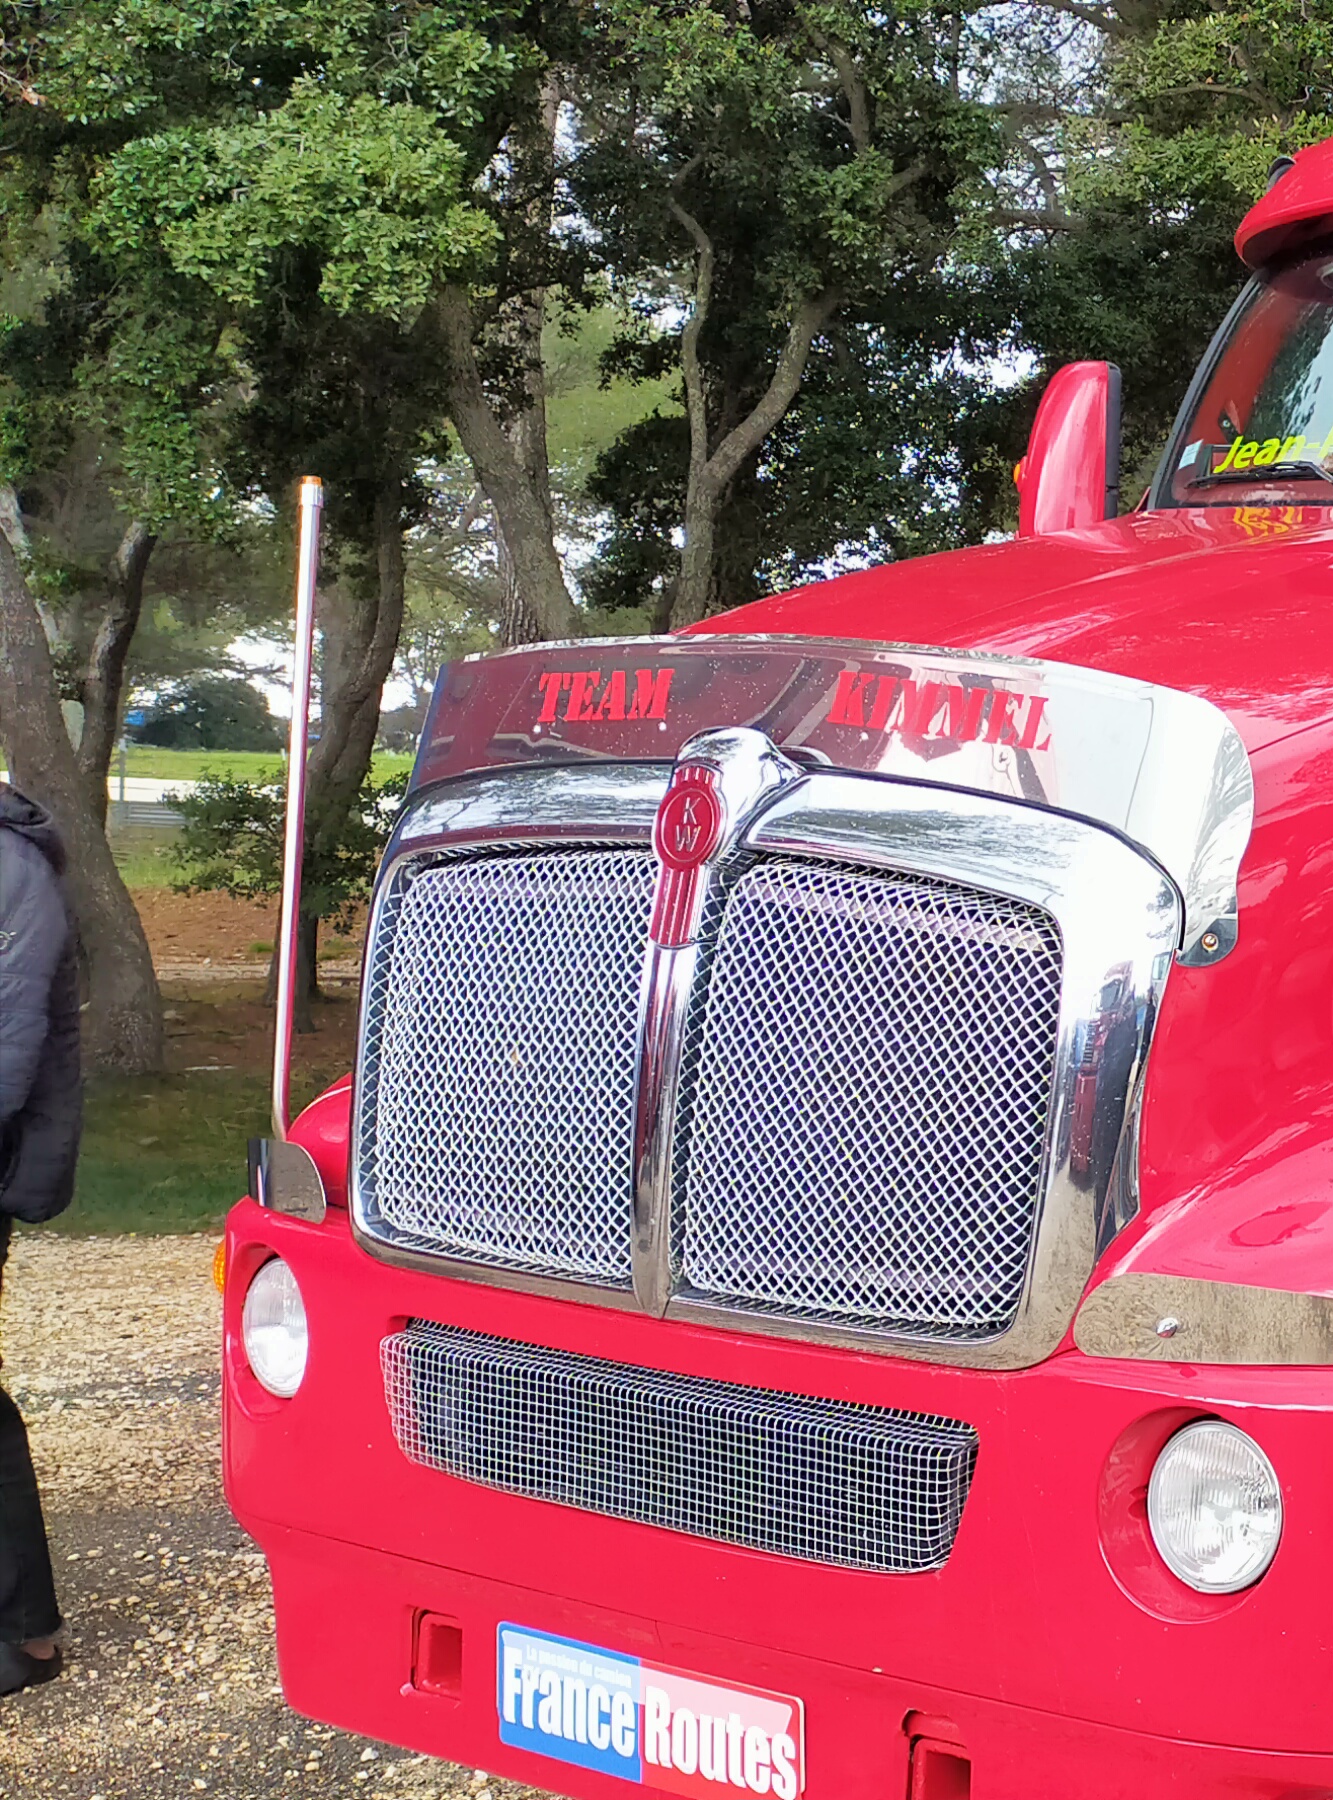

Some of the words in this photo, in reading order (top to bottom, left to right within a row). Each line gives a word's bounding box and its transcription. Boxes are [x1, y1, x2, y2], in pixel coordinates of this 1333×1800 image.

[537, 668, 675, 722] TEAM
[829, 670, 1051, 751] KIMMEL
[675, 824, 702, 853] W
[683, 797, 702, 825] K
[502, 1645, 637, 1757] France
[644, 1685, 798, 1800] Routes
